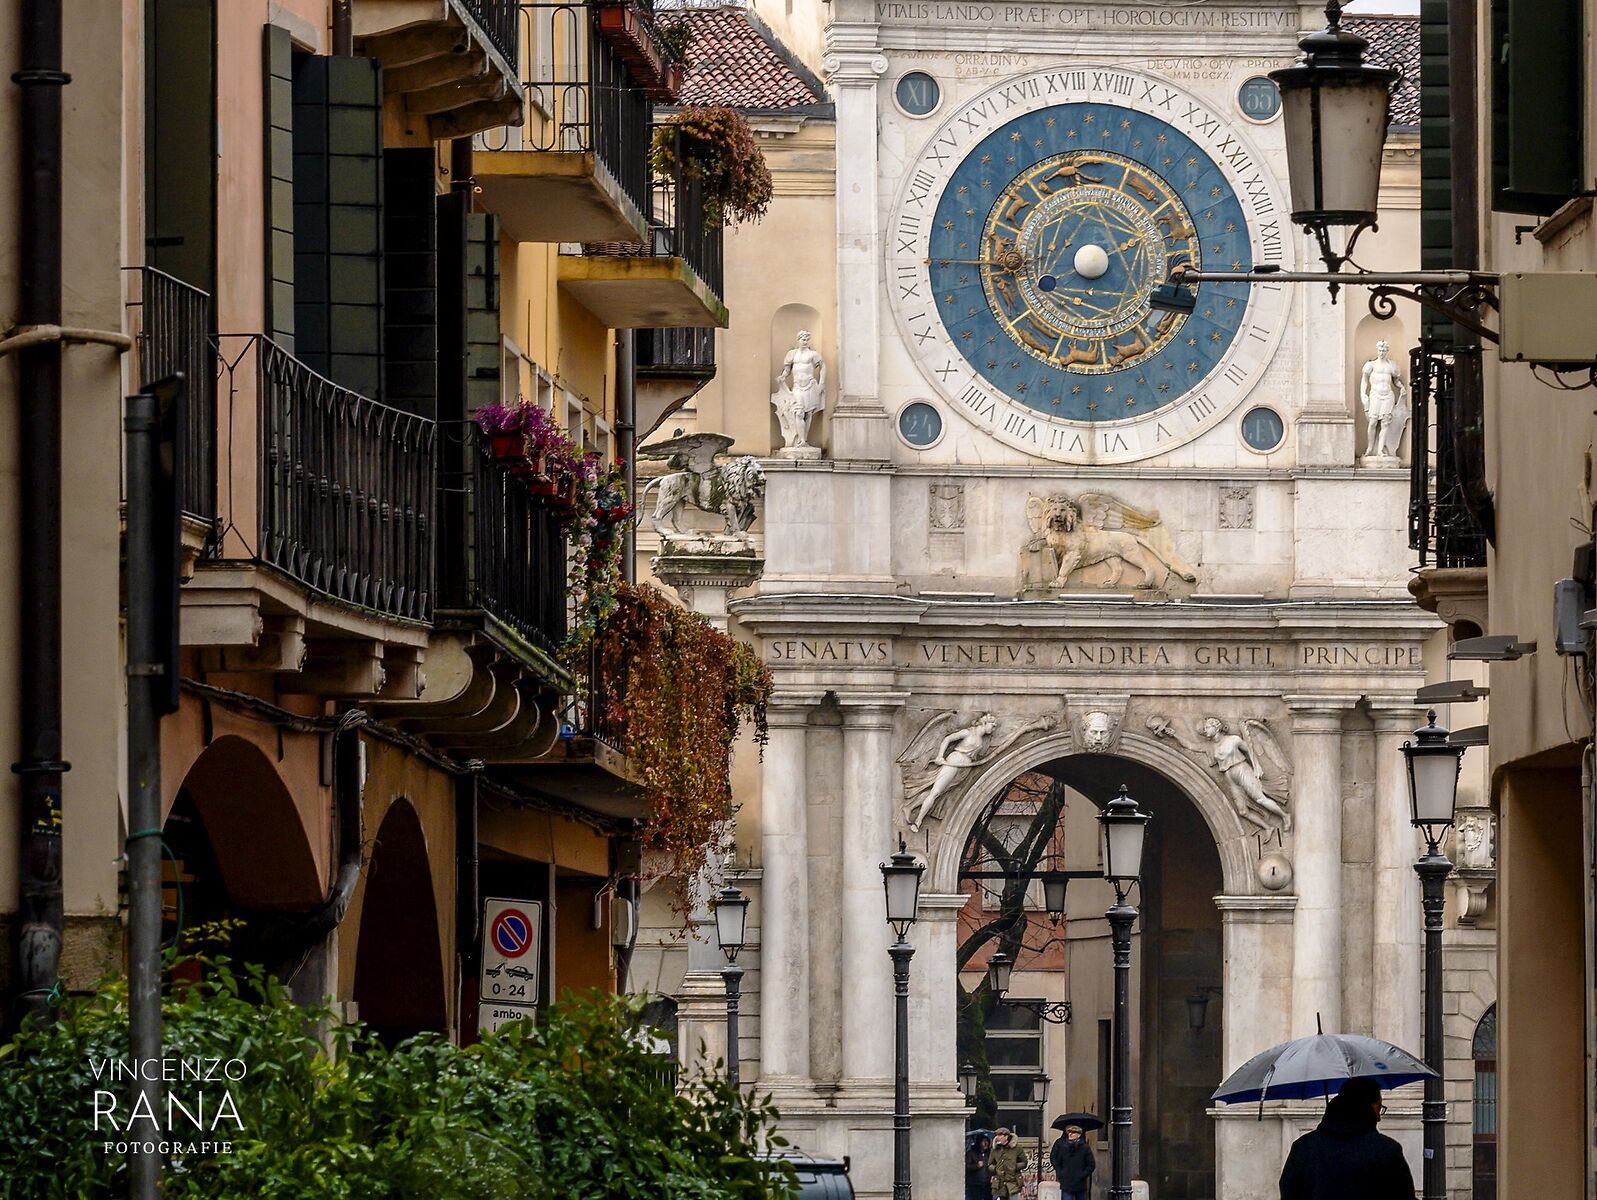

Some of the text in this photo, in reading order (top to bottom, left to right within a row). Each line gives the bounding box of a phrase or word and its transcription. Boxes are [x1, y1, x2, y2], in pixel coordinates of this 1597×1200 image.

[877, 3, 929, 19] VITALIS
[936, 5, 994, 21] LANDO
[1103, 10, 1215, 26] HOROLOGIVM
[1221, 11, 1299, 27] RESTITVIT
[907, 80, 927, 106] XI
[999, 78, 1041, 108] XVII
[1045, 72, 1086, 94] XVIII
[1093, 72, 1135, 96] XVIIII
[1140, 81, 1178, 110] XX
[958, 97, 999, 134] XVI
[1181, 102, 1220, 138] XXI
[925, 128, 958, 168] XV
[1216, 134, 1253, 174] XXII
[906, 170, 936, 208] XIIII
[1243, 173, 1274, 216] XXIII
[897, 215, 921, 254] XIII
[1259, 220, 1282, 261] XXIIII
[898, 266, 921, 300] XII
[908, 313, 936, 346] XI
[1249, 325, 1270, 343] II
[935, 360, 959, 382] X
[1224, 363, 1248, 386] III
[961, 385, 997, 422] VIIII
[1188, 393, 1217, 422] IIII
[1003, 413, 1037, 443] VIII
[1051, 429, 1085, 453] VII
[1156, 422, 1172, 442] V
[1103, 433, 1128, 453] VI
[772, 641, 887, 660] SENATVS
[922, 644, 1037, 664] VENETVS
[1058, 645, 1171, 665] ANDREA
[1303, 647, 1422, 665] PRINCIPE
[493, 1009, 522, 1020] ambo
